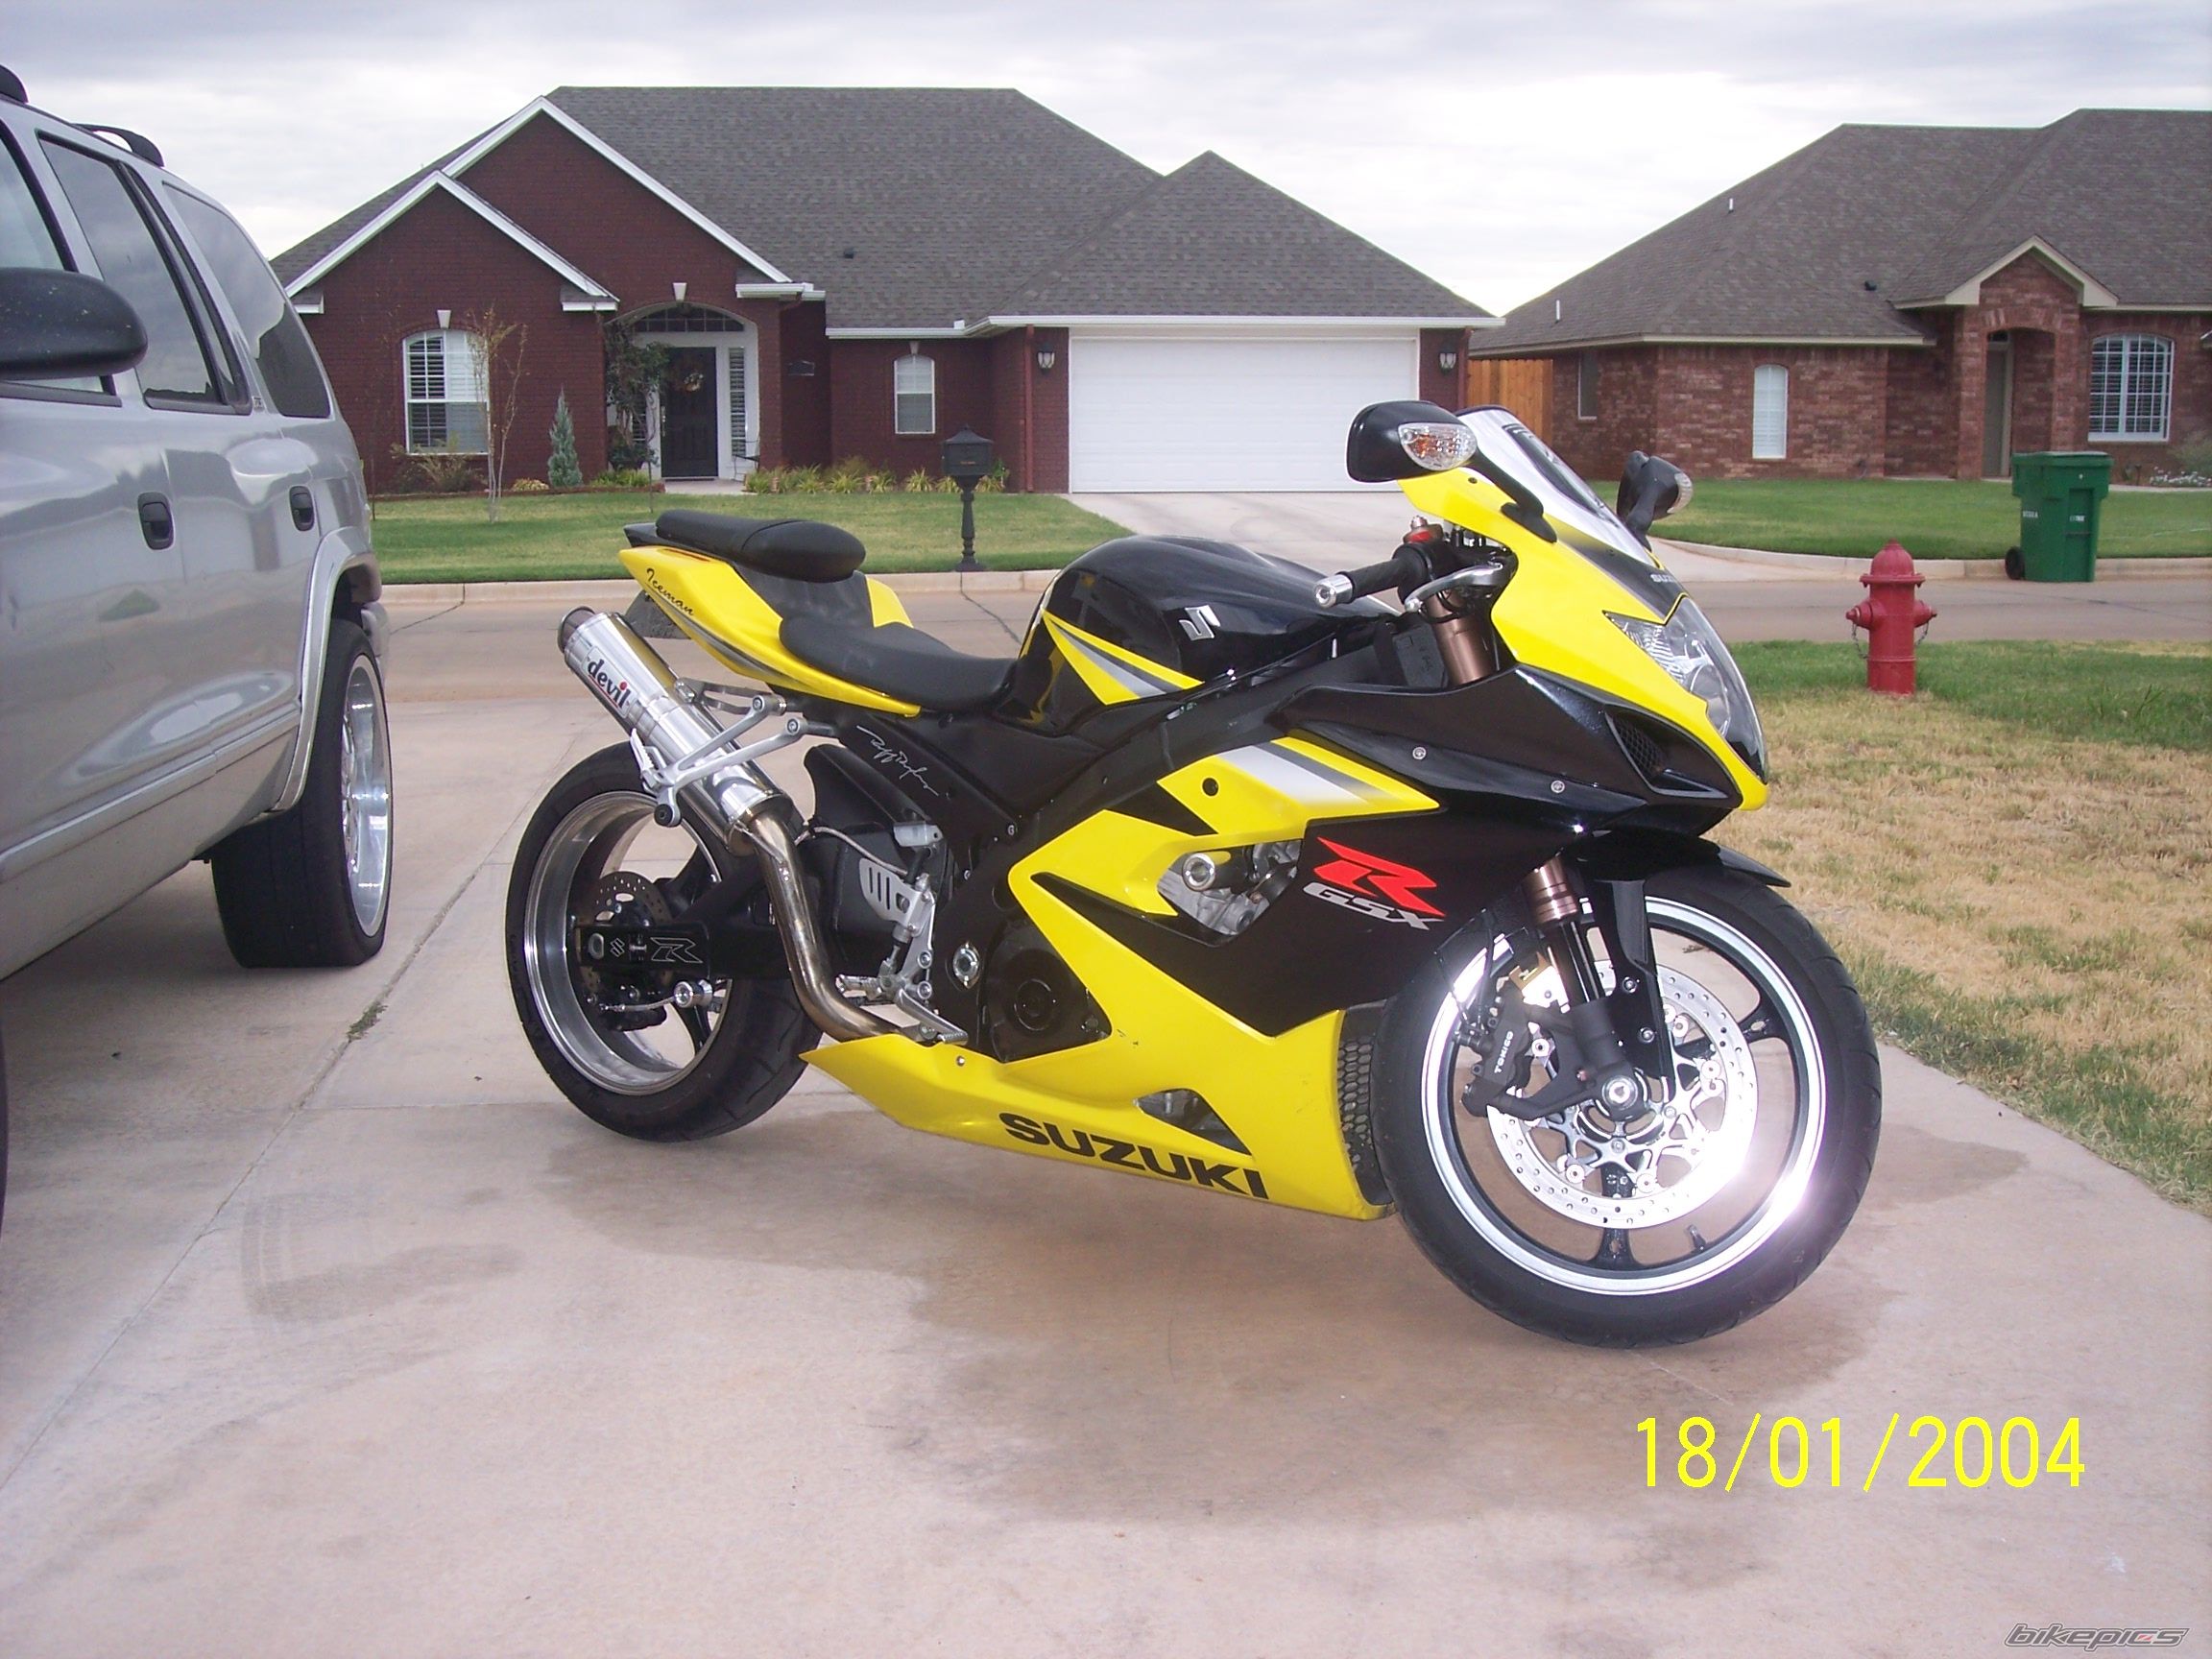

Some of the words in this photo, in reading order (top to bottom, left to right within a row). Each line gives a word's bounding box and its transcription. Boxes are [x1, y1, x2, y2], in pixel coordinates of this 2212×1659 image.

[588, 659, 631, 709] devil
[1303, 881, 1444, 930] GSX
[998, 1112, 1269, 1200] SUZUKI
